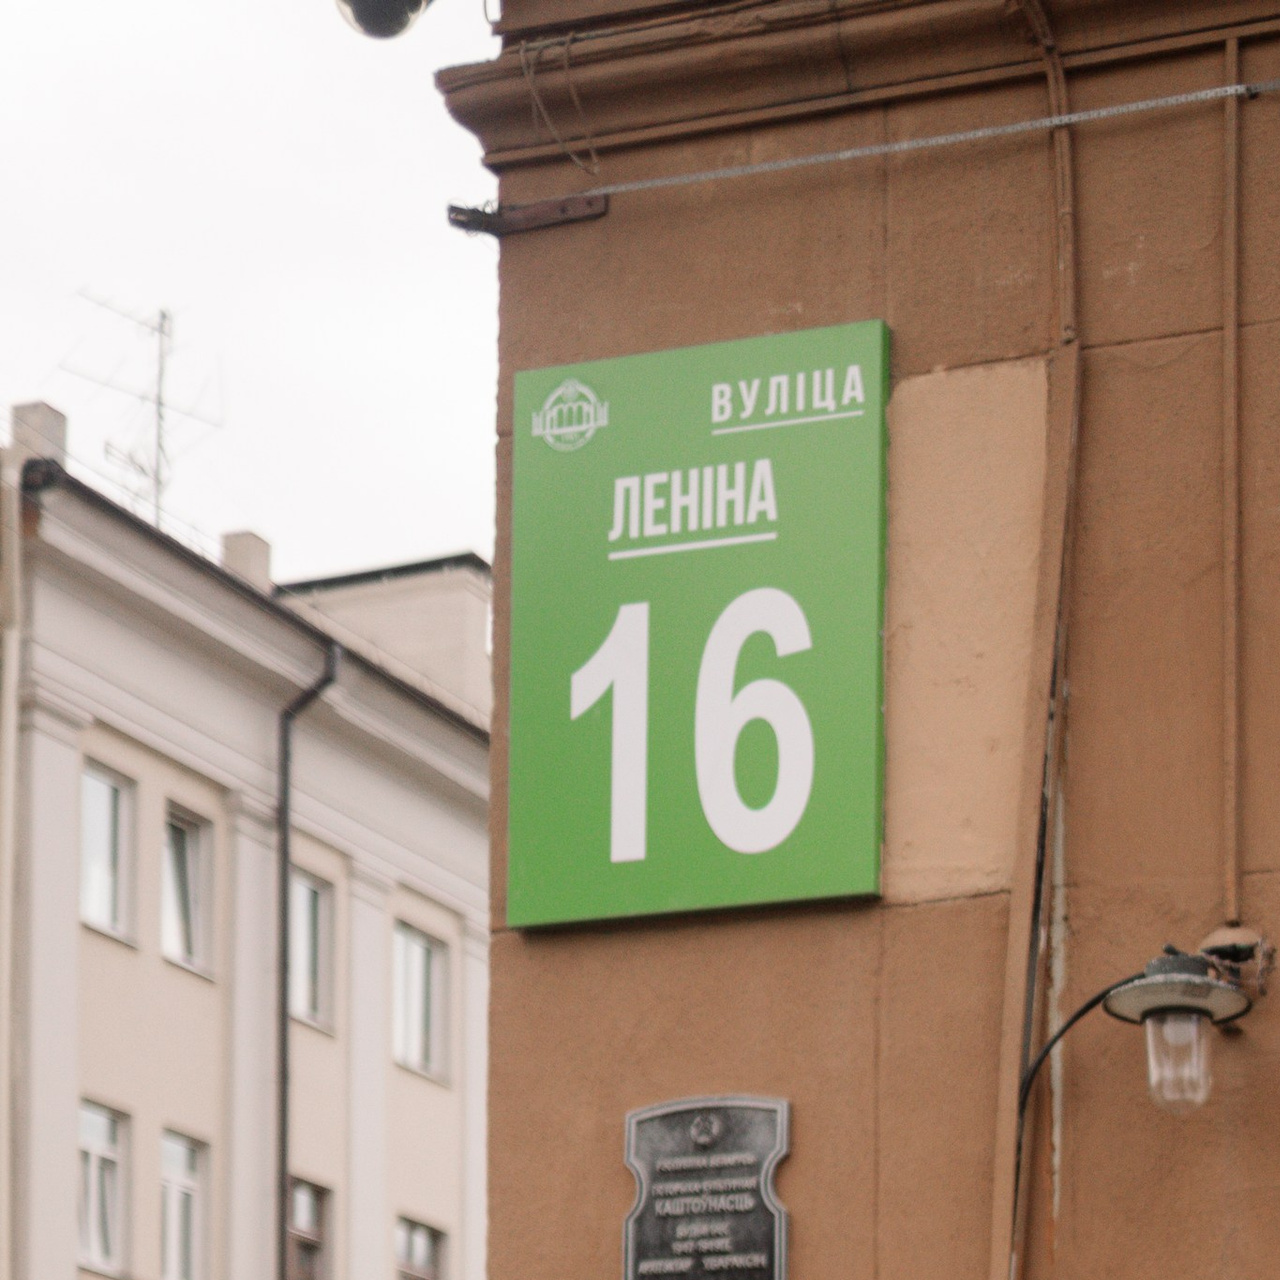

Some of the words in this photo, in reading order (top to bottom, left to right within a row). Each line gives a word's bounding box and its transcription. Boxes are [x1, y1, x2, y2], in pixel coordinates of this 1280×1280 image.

[711, 364, 865, 423] ВУЛІЦА
[608, 459, 778, 541] ЛЕНІНА
[571, 587, 814, 863] 16
